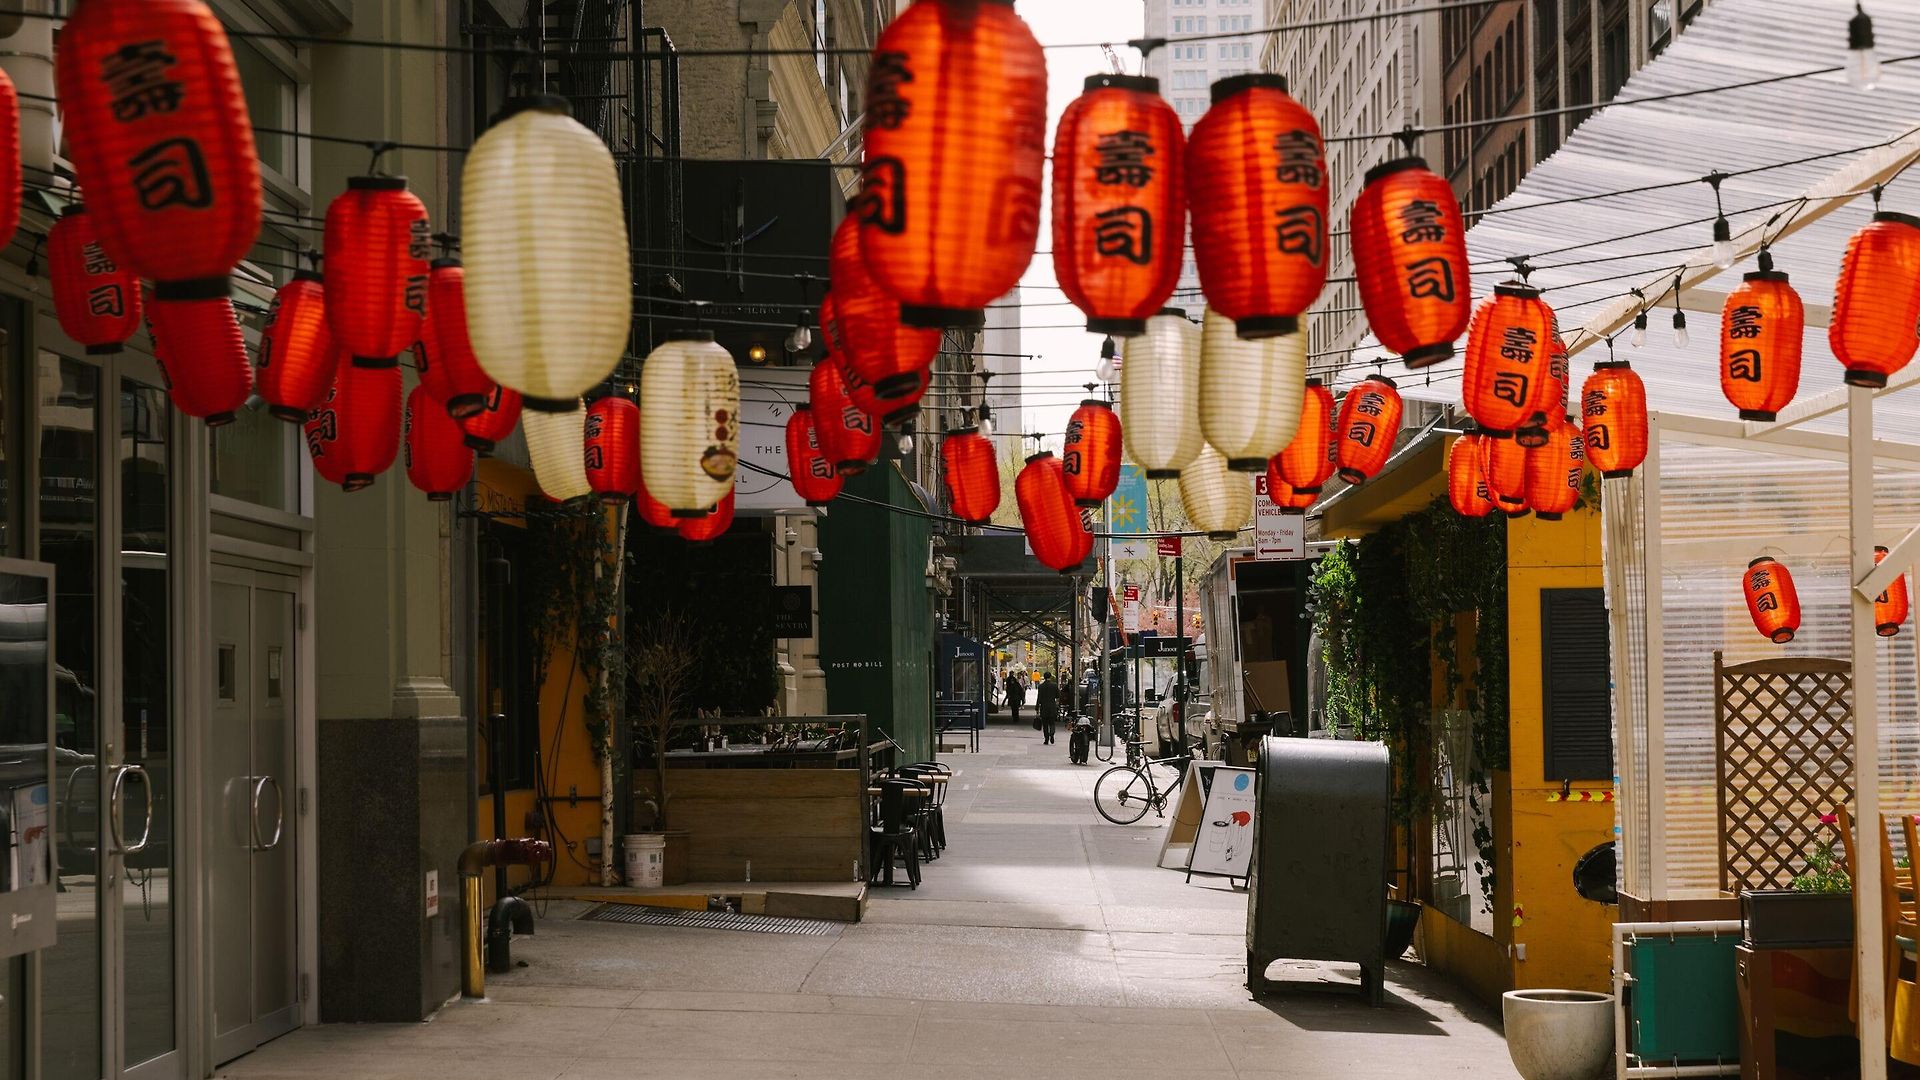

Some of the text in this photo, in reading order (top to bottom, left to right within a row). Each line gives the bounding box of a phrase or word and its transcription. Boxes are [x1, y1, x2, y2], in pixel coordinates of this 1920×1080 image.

[101, 39, 213, 210] 壽司
[1093, 129, 1155, 266] 壽司
[1273, 129, 1323, 267] 壽司
[1397, 200, 1455, 303] 壽司
[1494, 327, 1537, 408] 壽司
[1729, 306, 1762, 383] 壽司
[768, 403, 782, 417] IN
[1349, 392, 1385, 447] 壽司
[1584, 391, 1609, 451] 壽司
[755, 446, 781, 454] THE
[1260, 477, 1268, 494] 3
[1751, 569, 1778, 613] 壽司
